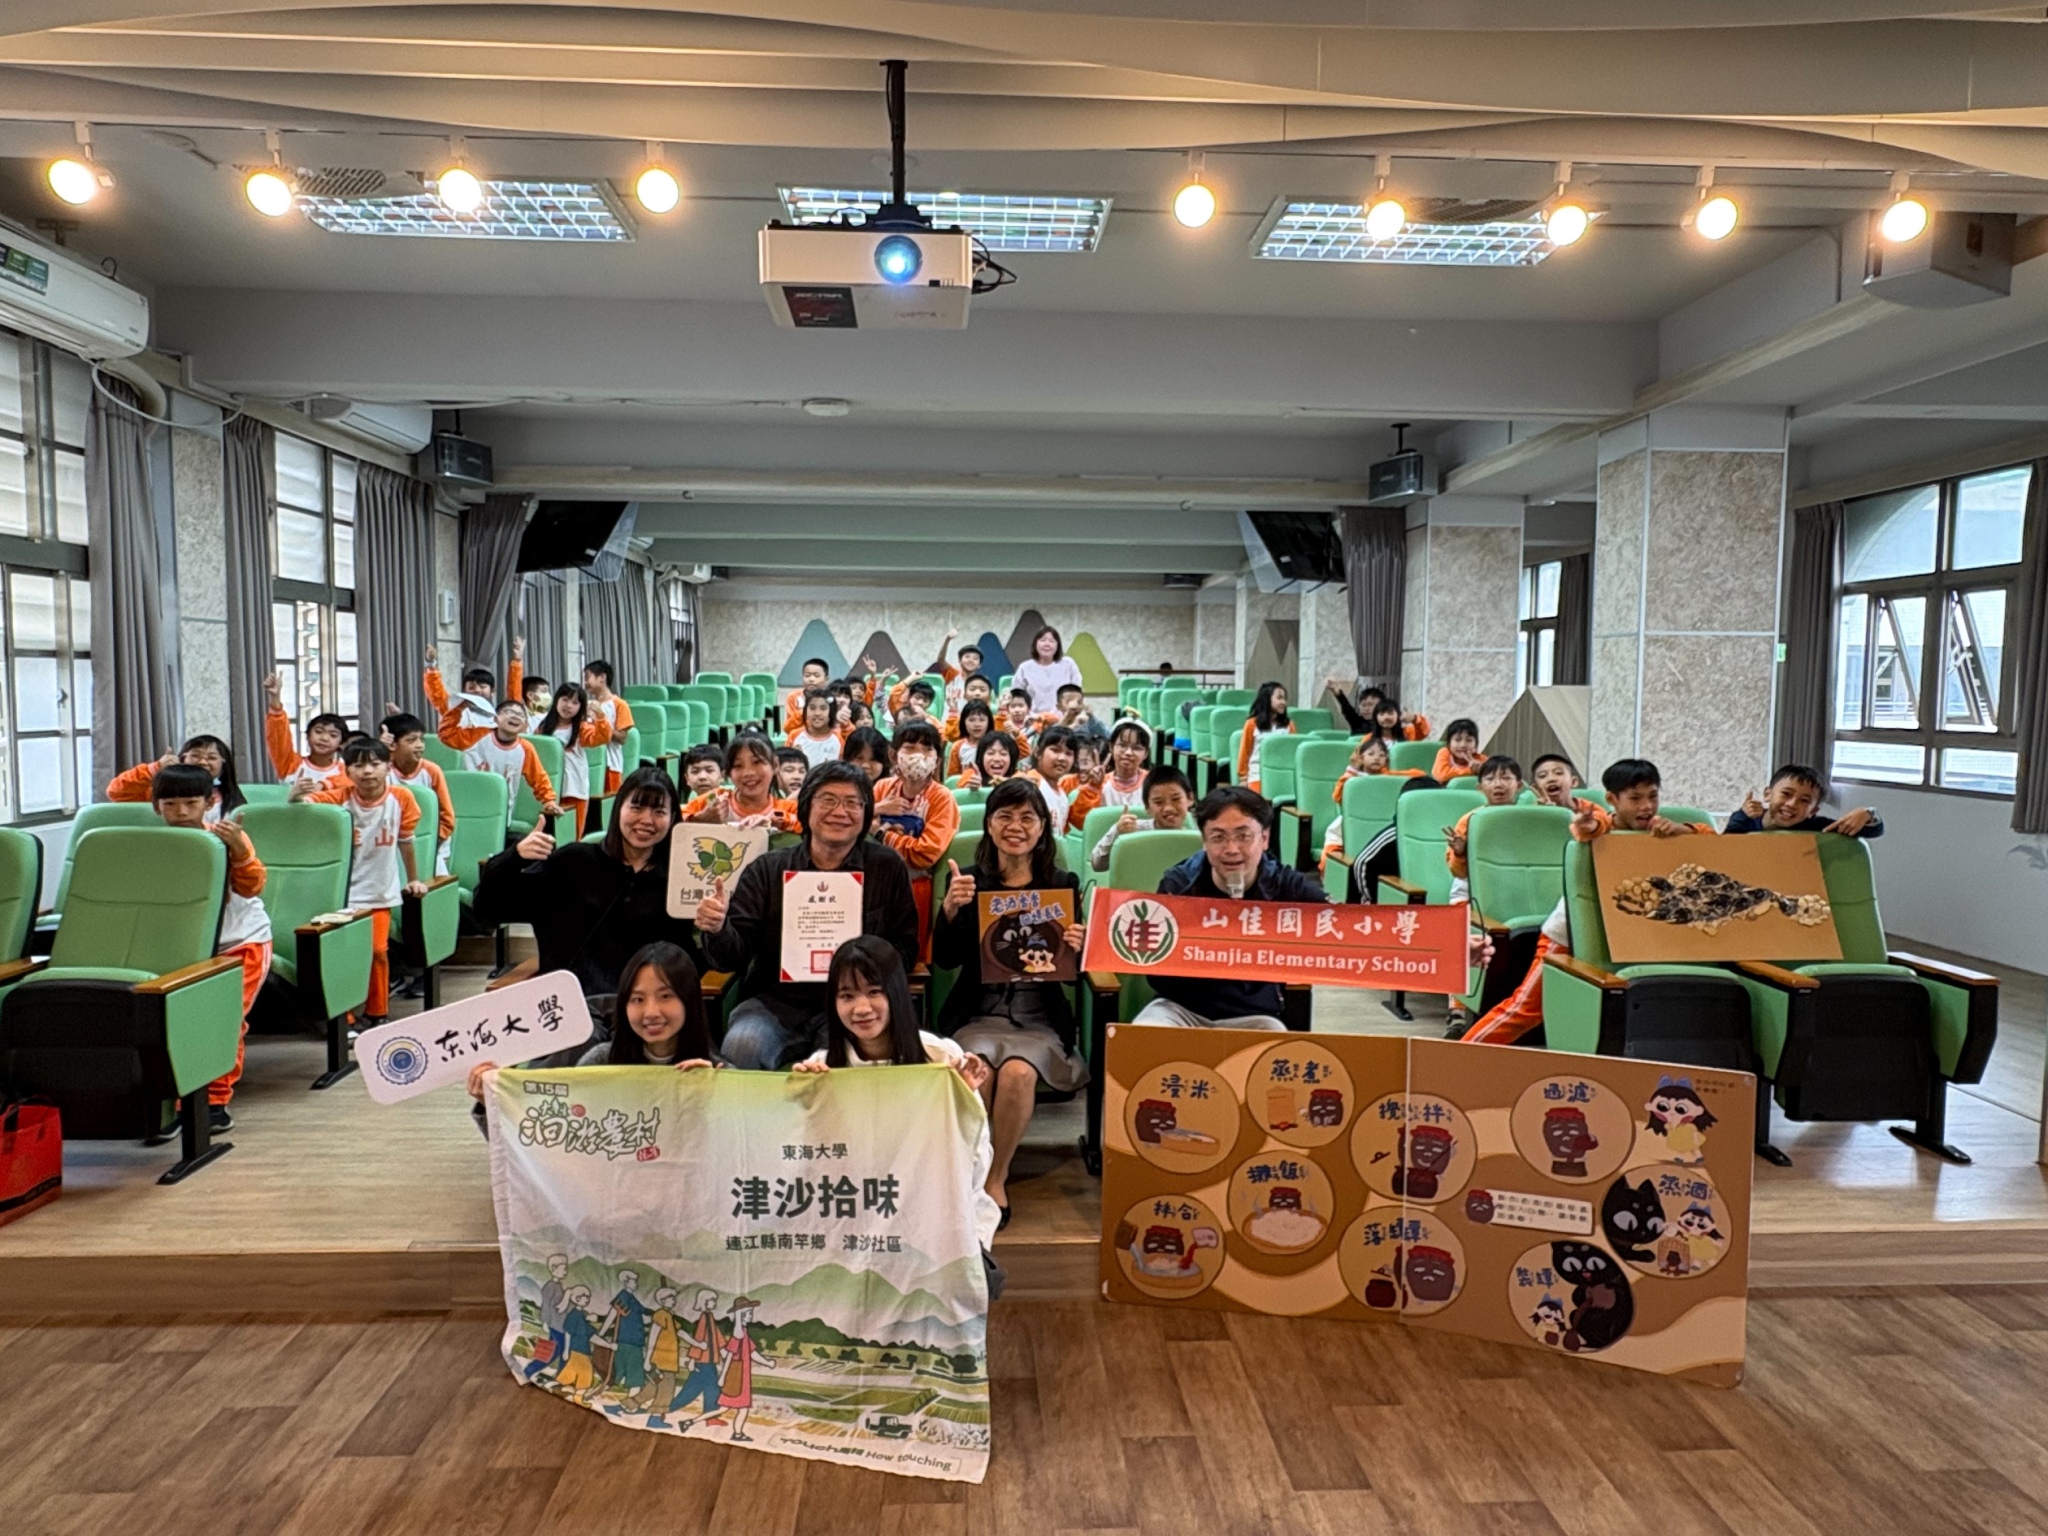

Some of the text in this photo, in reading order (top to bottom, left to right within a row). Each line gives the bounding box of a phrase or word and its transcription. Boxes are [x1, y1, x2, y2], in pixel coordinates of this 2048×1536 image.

[1202, 907, 1421, 945] 山佳國民小學
[1182, 945, 1437, 975] Shanjia Elementary School
[524, 1081, 568, 1096] 第15屆
[782, 1143, 848, 1160] 東海大學
[731, 1174, 900, 1220] 津沙拾味
[726, 1233, 902, 1252] 連江縣南竿鄉 津沙社區
[865, 1450, 894, 1462] How
[897, 1453, 953, 1472] touching
